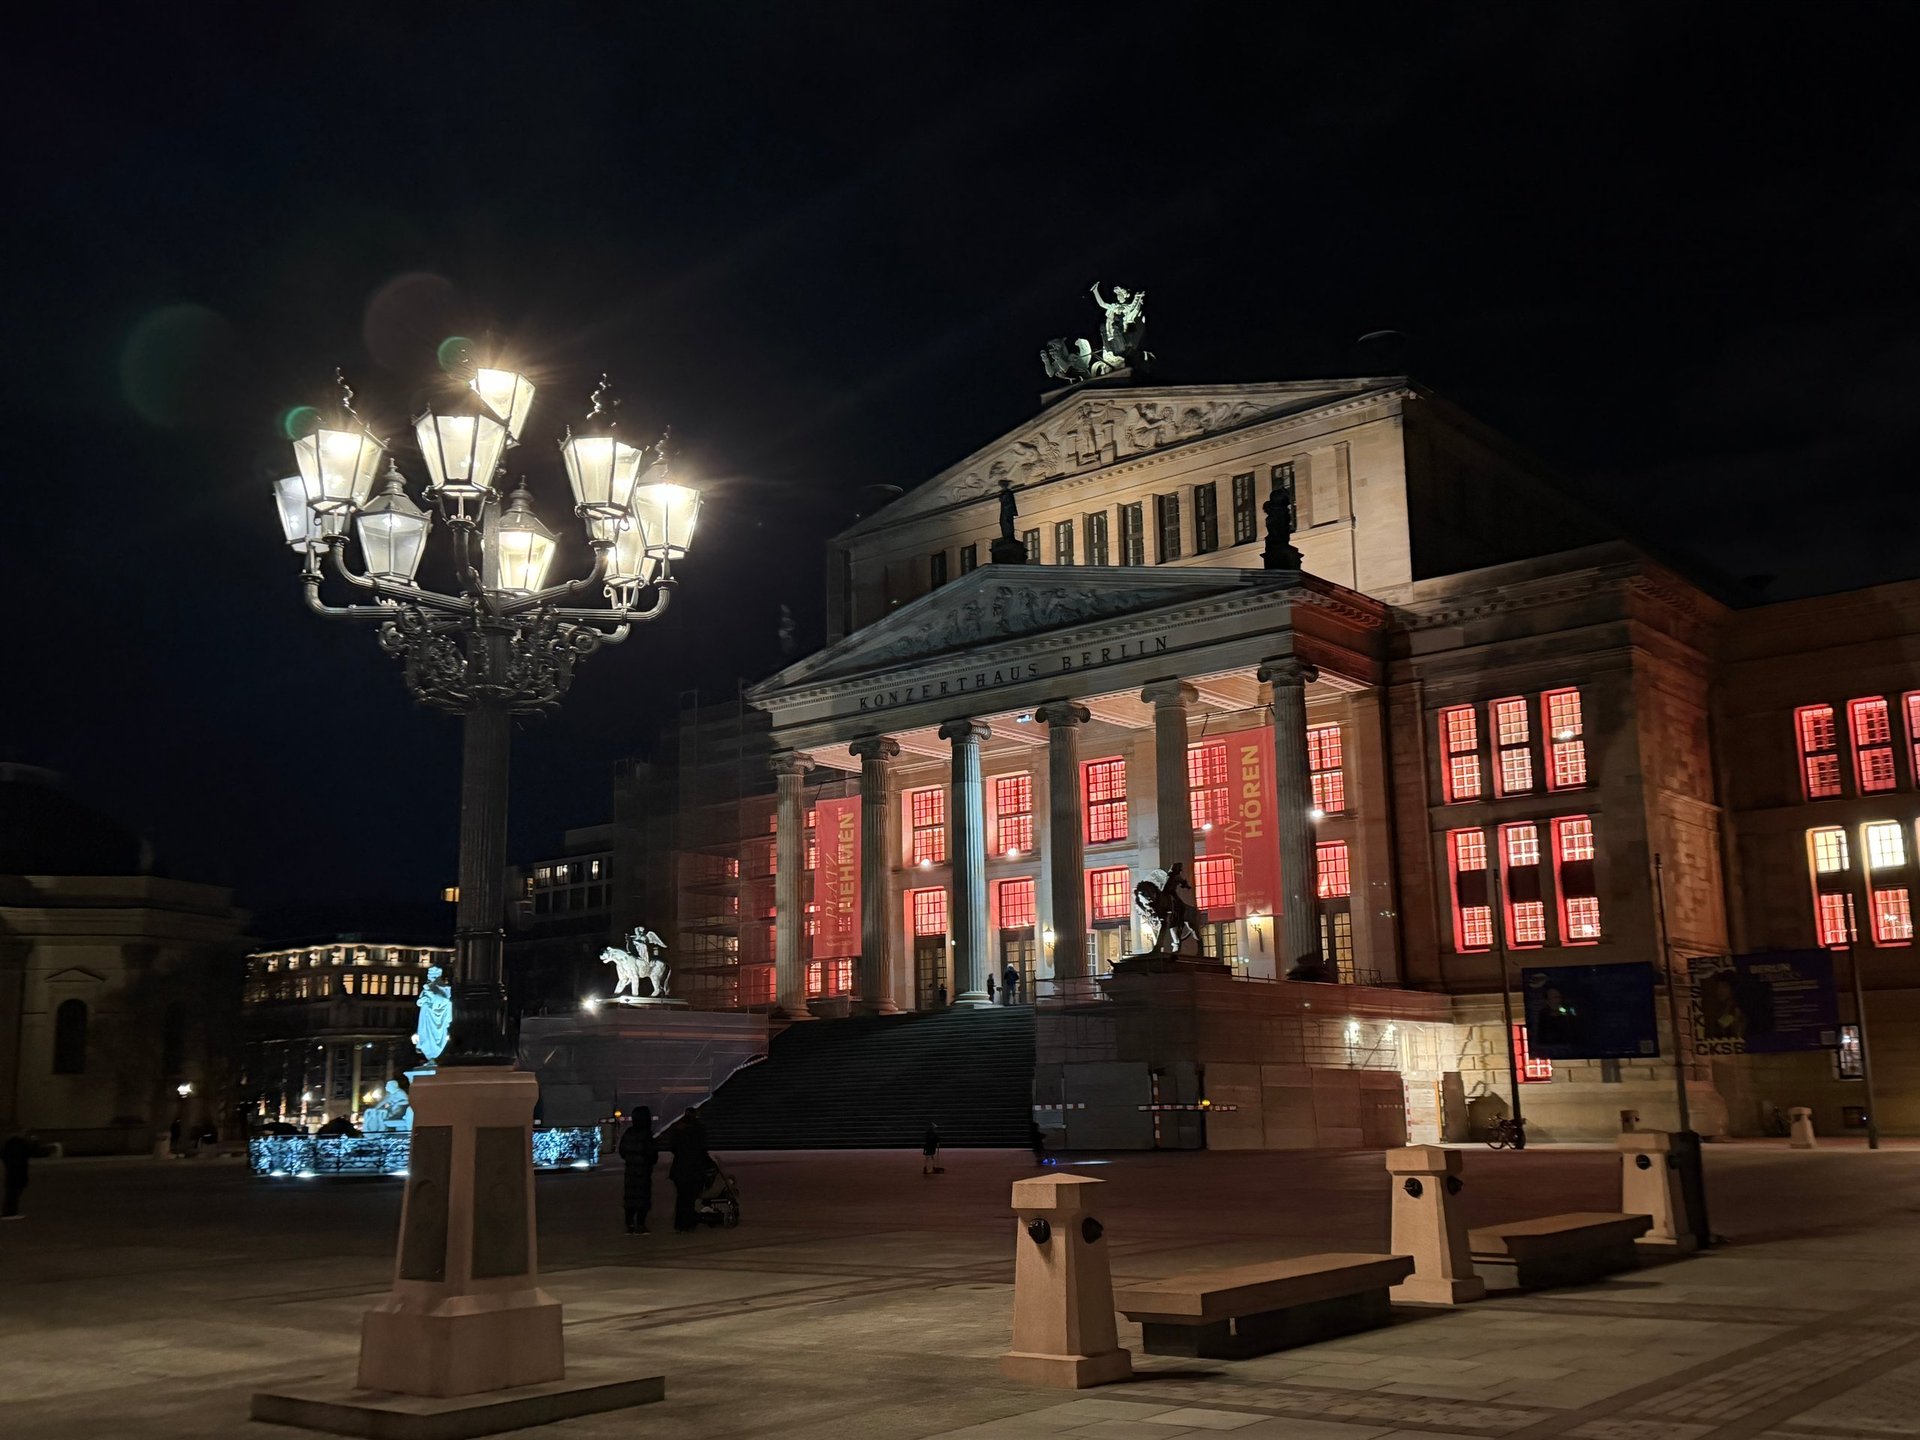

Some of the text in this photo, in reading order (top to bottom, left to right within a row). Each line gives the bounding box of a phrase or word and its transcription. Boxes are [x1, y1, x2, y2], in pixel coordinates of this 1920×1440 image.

[859, 635, 1168, 710] KONZERTHAUS BERLIN
[1239, 745, 1264, 838] HÖREN
[825, 852, 839, 919] PLATZ
[839, 812, 855, 914] NEHMEN
